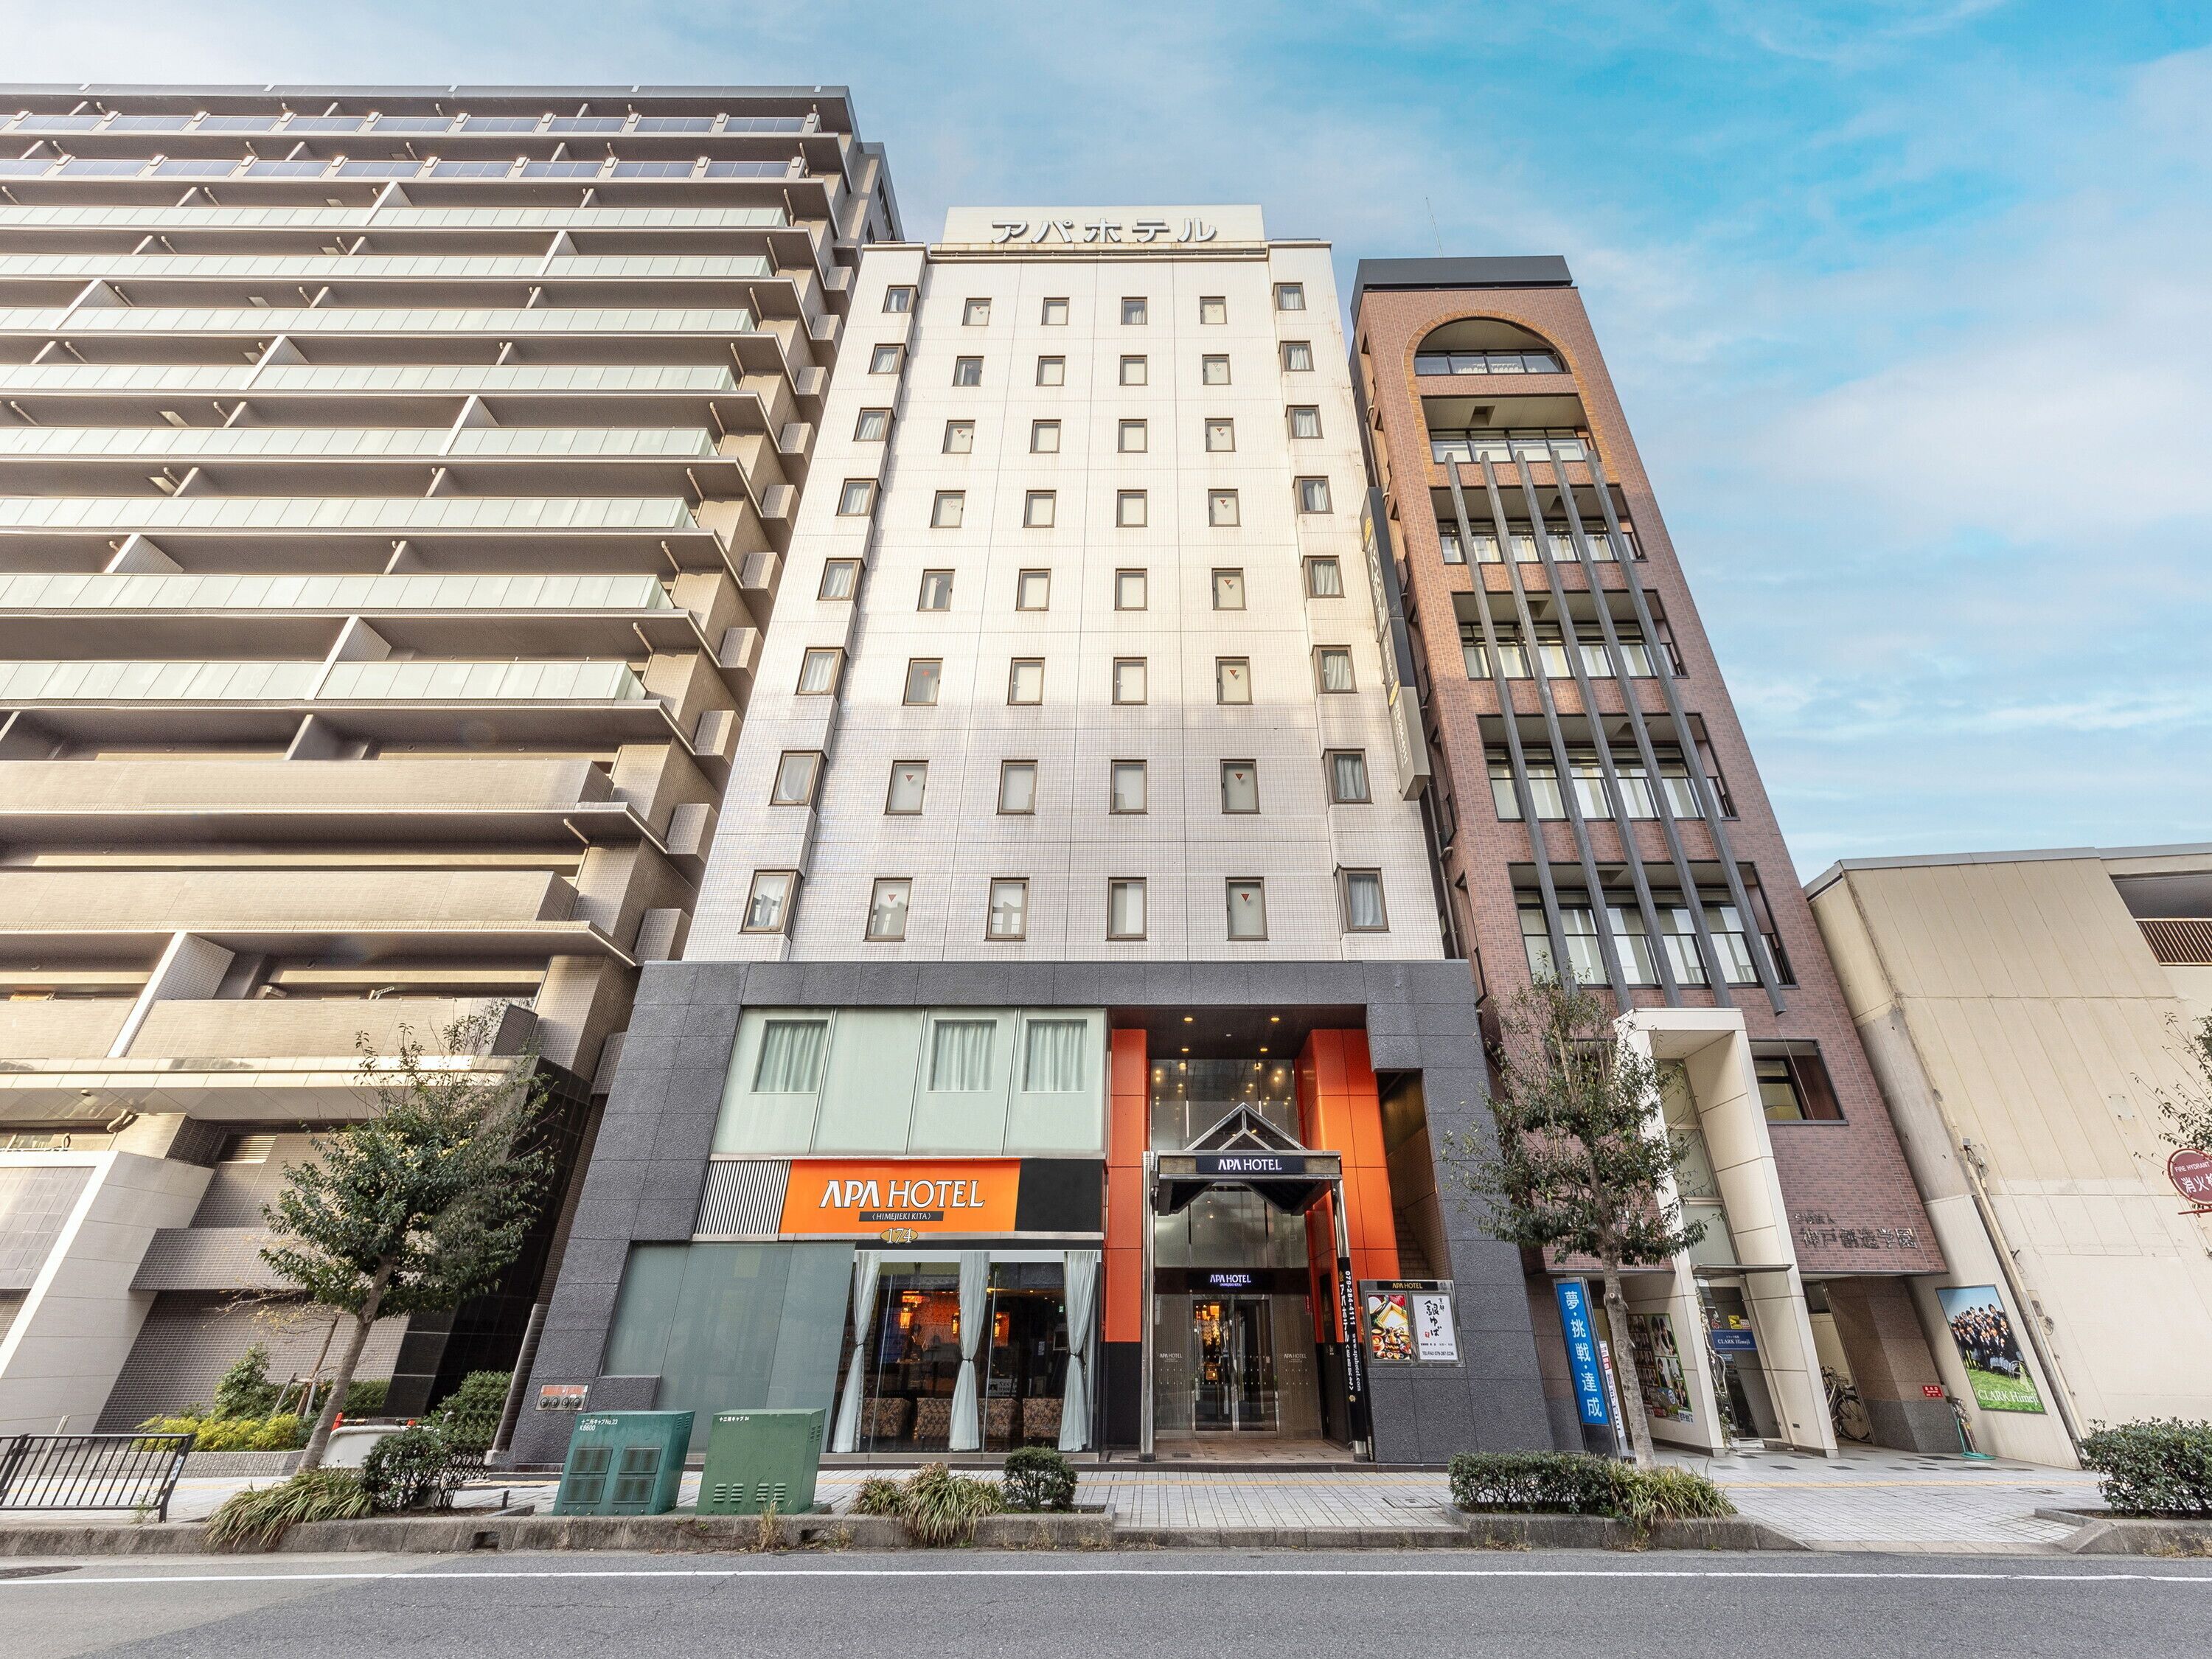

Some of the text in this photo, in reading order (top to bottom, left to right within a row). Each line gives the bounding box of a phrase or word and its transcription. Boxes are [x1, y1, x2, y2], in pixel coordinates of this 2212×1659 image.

[992, 218, 1217, 244] アパホテル
[1367, 535, 1385, 633] アパホテル
[1218, 1158, 1282, 1171] APA HOTEL
[2174, 1161, 2211, 1173] FIRE HYDRANT
[818, 1180, 986, 1208] APA HOTEL
[886, 1227, 914, 1245] 174
[1799, 1228, 1919, 1250] 神戸創造学園
[1210, 1274, 1251, 1283] APA HOTEL
[1344, 1270, 1362, 1391] 079-284-4111 www.apahotel.com
[1978, 1390, 2039, 1406] CLARK Himeji
